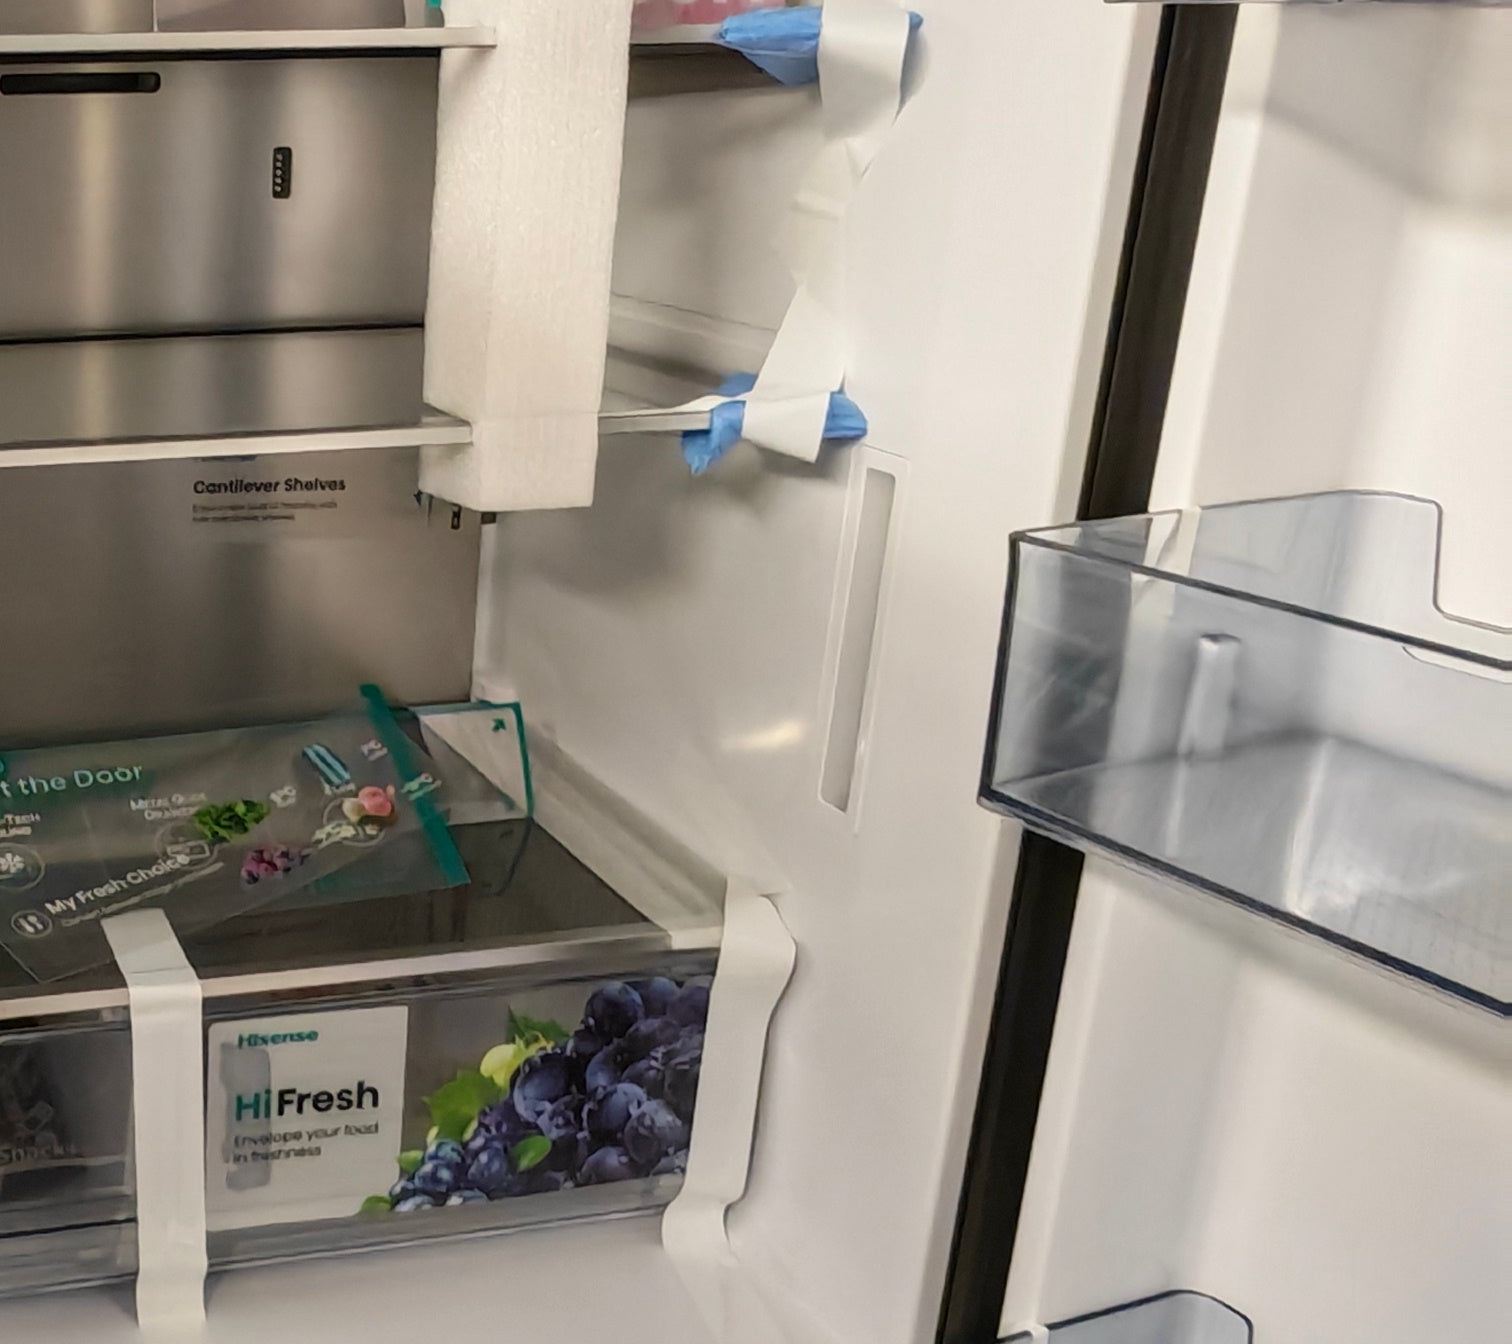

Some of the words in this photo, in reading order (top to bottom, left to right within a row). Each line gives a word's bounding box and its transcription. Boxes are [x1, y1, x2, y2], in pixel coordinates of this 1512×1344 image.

[193, 478, 281, 495] Cantilever
[284, 477, 347, 492] Shelves
[17, 775, 67, 796] the
[73, 765, 142, 788] Door
[44, 897, 77, 915] My
[76, 877, 128, 905] Fresh
[126, 854, 190, 885] Choice
[237, 1029, 319, 1050] Hisense
